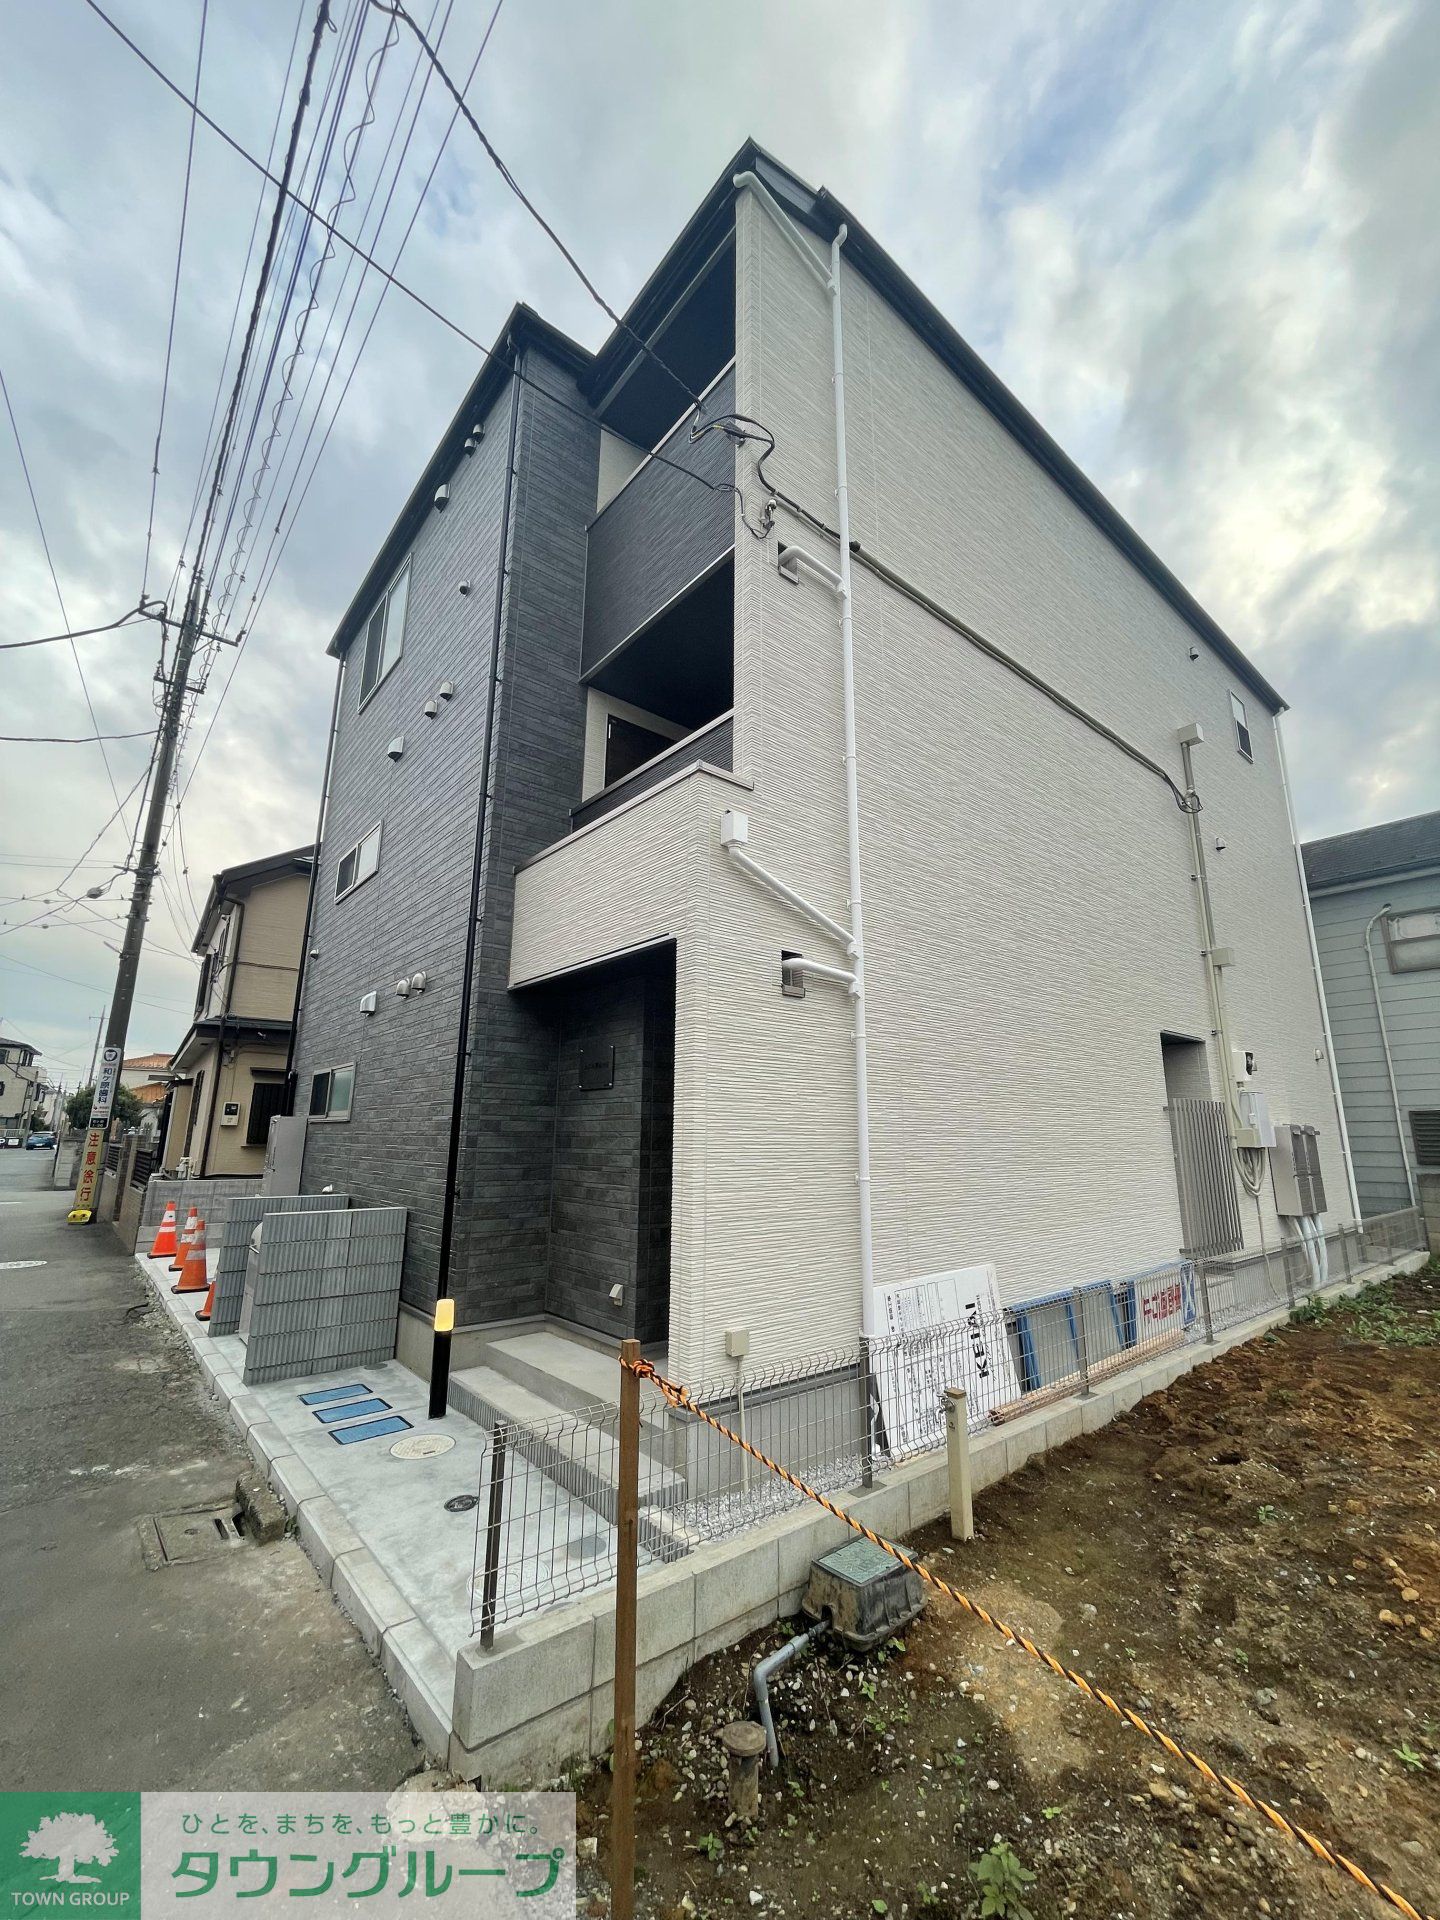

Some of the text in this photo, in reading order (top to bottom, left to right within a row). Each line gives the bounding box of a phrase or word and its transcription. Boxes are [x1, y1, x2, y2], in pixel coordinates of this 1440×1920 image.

[80, 1132, 100, 1203] 注意徐行
[965, 1303, 989, 1379] KEIAI
